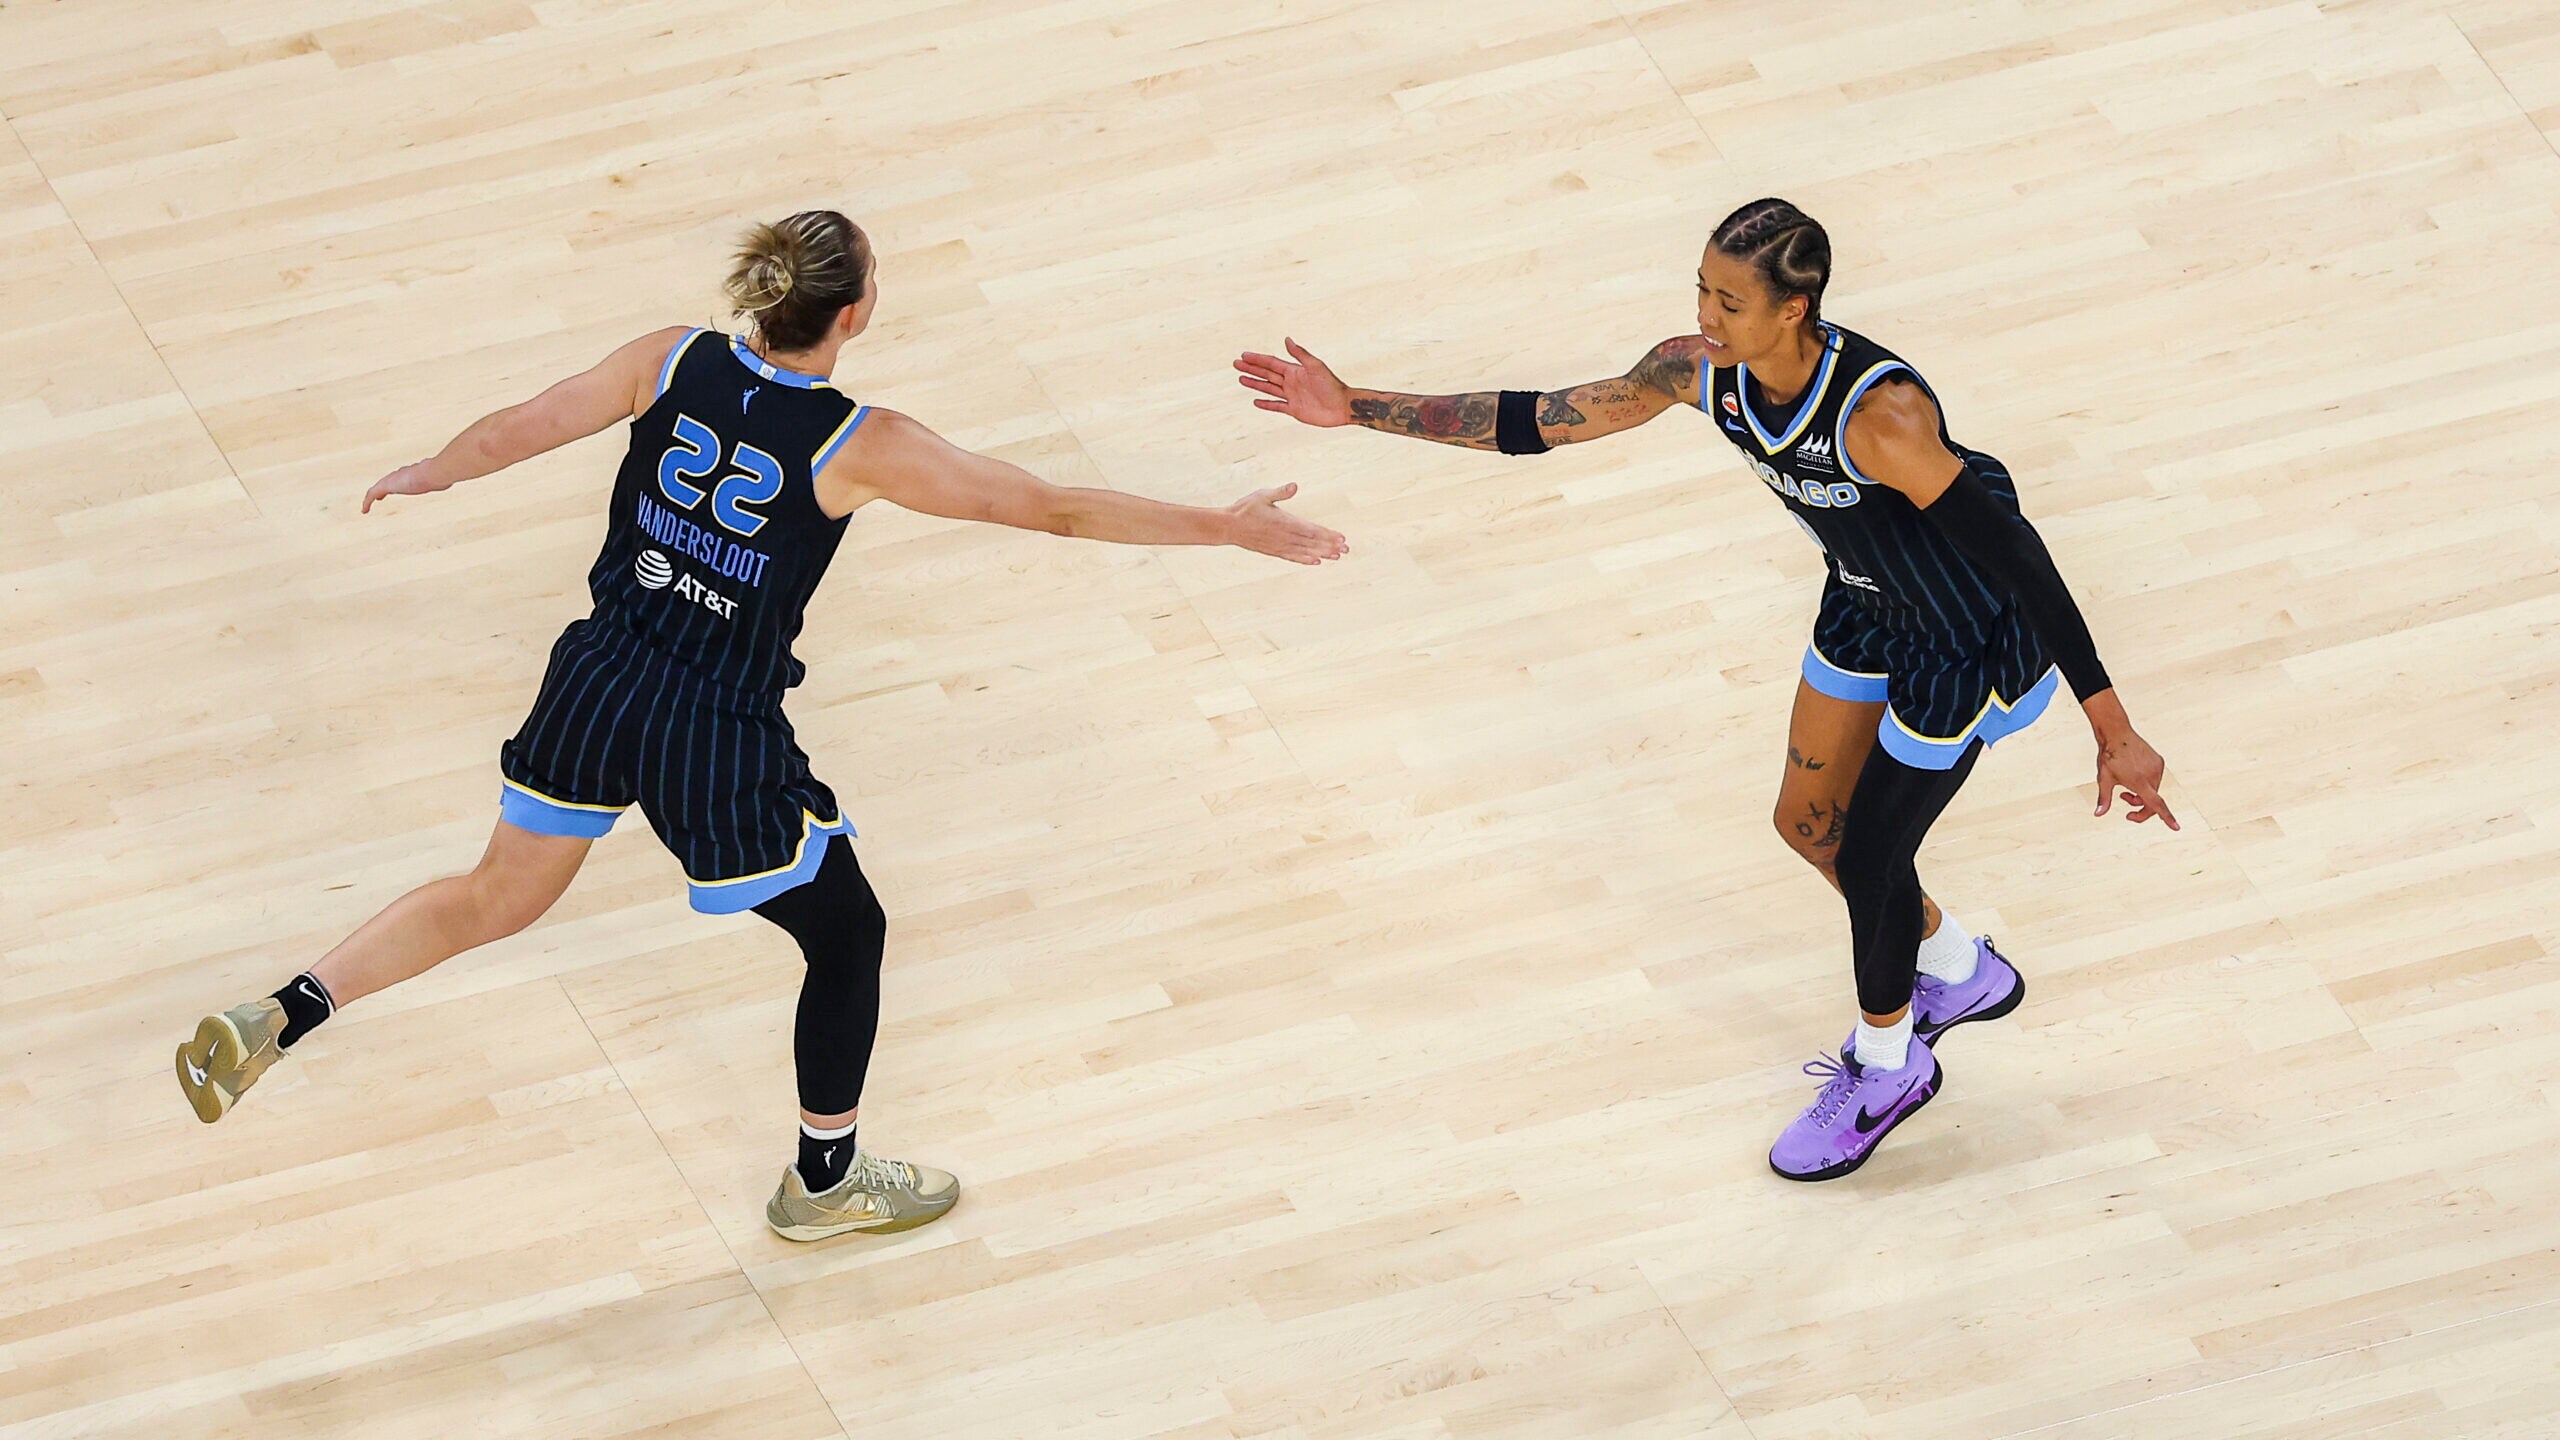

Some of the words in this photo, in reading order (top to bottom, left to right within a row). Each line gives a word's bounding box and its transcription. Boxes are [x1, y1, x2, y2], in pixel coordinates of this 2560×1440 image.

[658, 412, 784, 537] 22
[1796, 452, 1833, 466] MAGELLAN
[637, 490, 770, 588] VANDERSLOOT
[673, 572, 739, 620] AT&T
